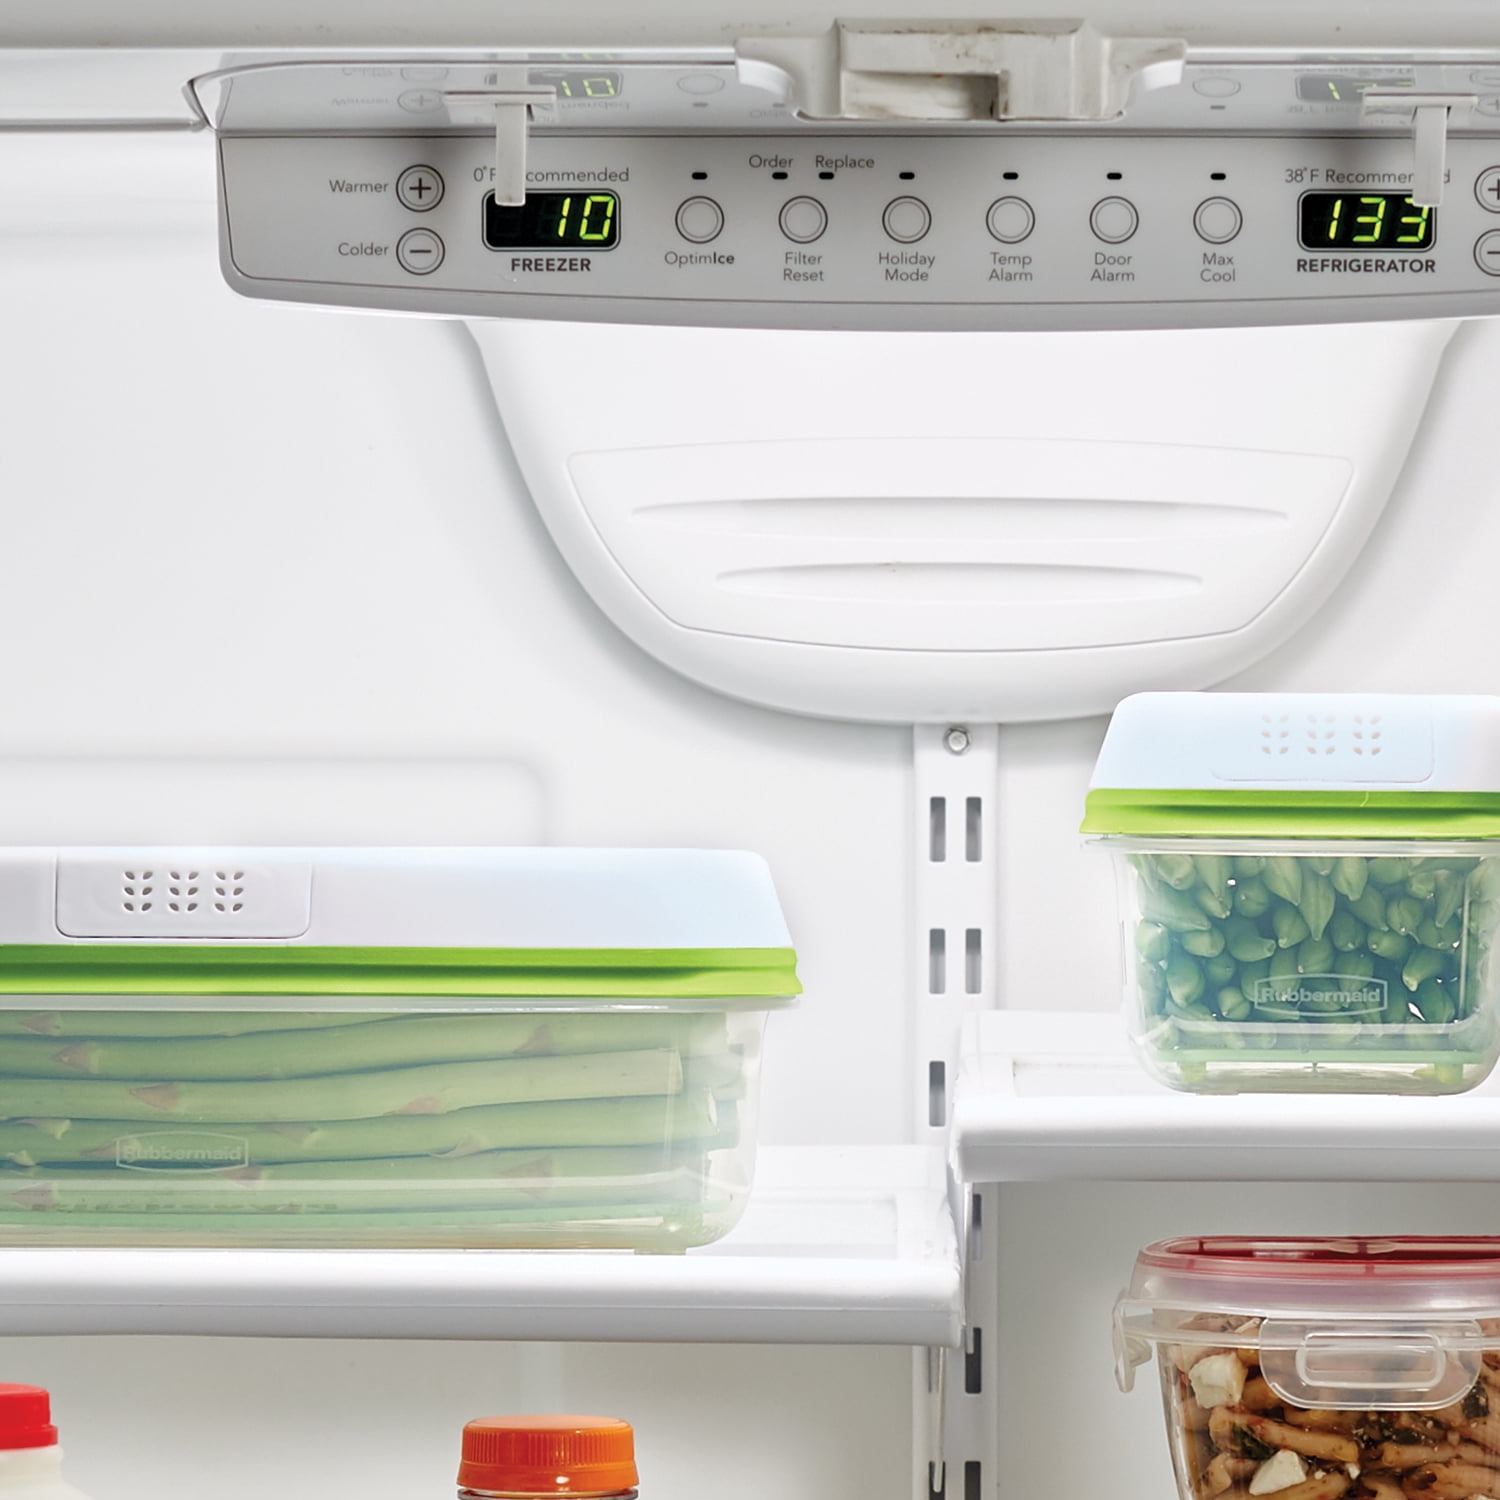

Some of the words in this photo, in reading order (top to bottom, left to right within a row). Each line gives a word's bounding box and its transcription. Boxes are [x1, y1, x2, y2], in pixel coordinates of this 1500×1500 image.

[749, 154, 793, 169] Order
[815, 155, 875, 172] Replace
[525, 167, 630, 182] commended
[1326, 169, 1451, 184] Recommend
[329, 180, 389, 193] Warmer
[558, 195, 615, 240] 10
[1328, 197, 1430, 242] 133
[338, 243, 389, 257] Colder
[511, 258, 592, 272] FREEZER
[664, 251, 735, 268] OptimIce
[785, 251, 823, 265] Filter
[878, 251, 936, 269] Holiday
[990, 252, 1032, 269] Temp
[1094, 252, 1133, 266] Door
[1202, 252, 1234, 266] Max
[1296, 259, 1436, 273] REFRIGERATOR
[783, 268, 824, 282] Reset
[885, 268, 929, 282] Mode
[988, 268, 1033, 282] Alarm
[1090, 268, 1135, 282] Alarm
[1200, 268, 1236, 282] Cool
[1261, 988, 1380, 1002] Rubbermaid
